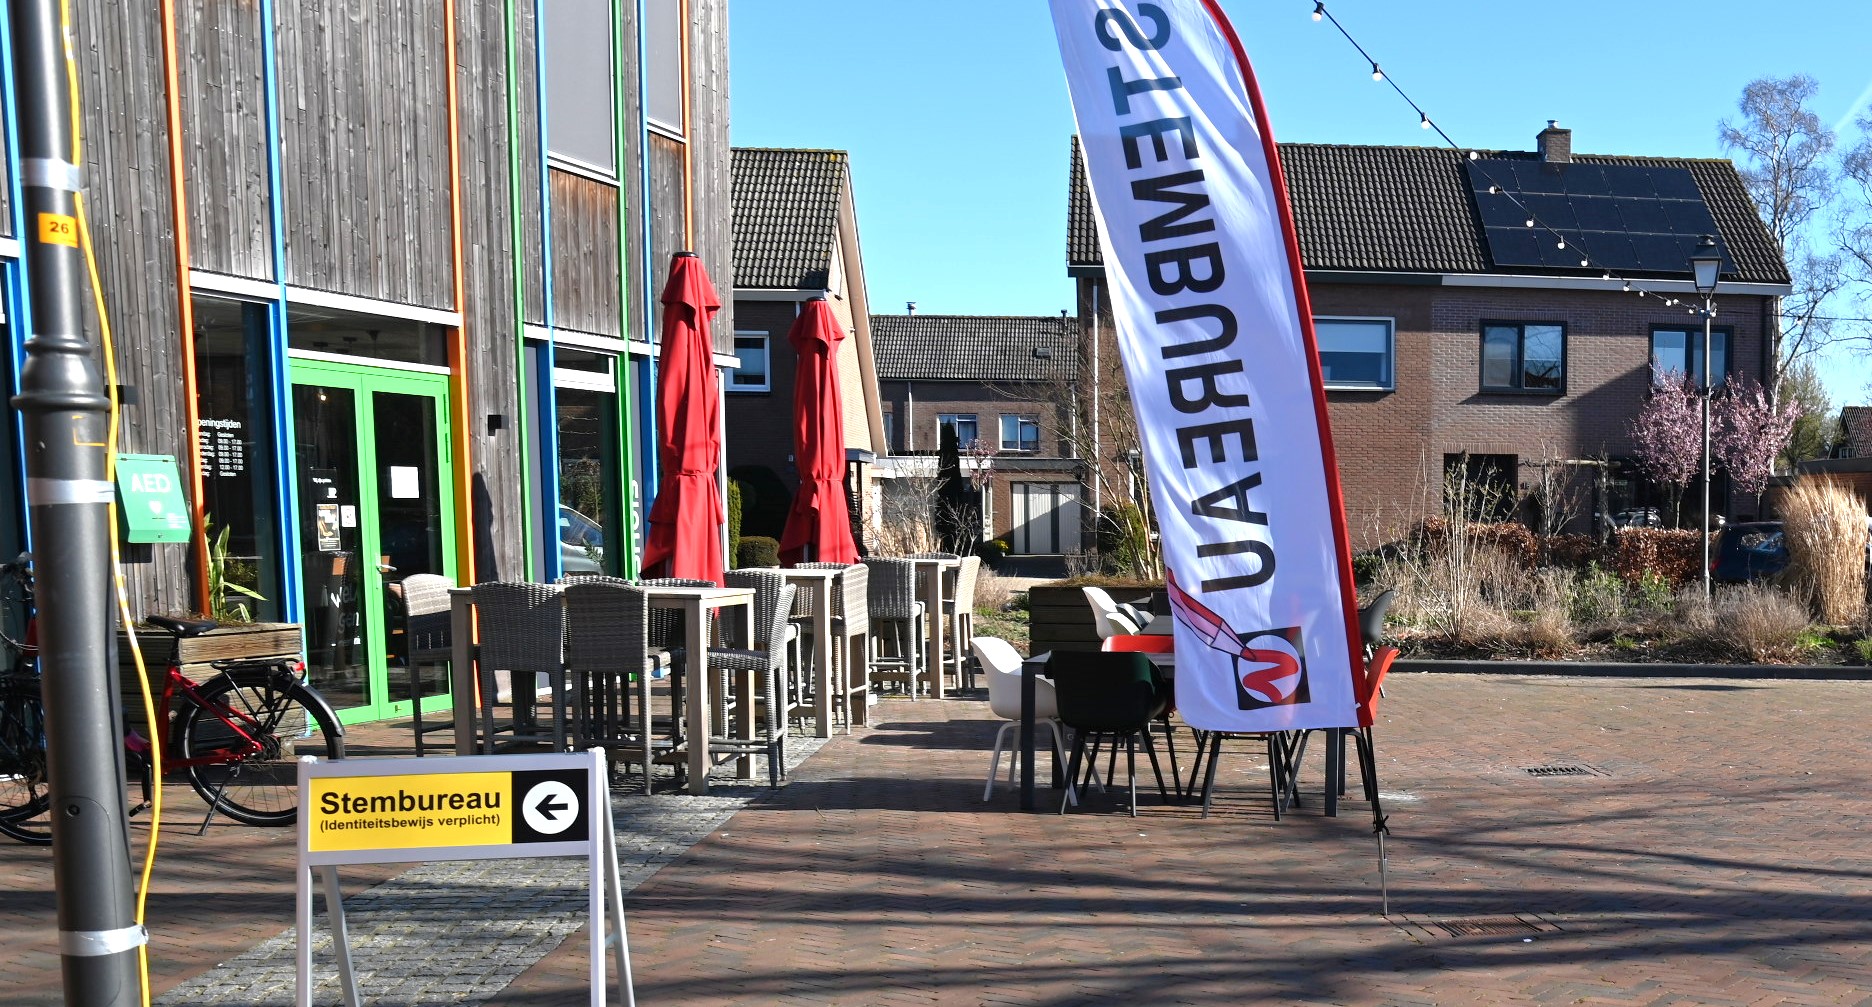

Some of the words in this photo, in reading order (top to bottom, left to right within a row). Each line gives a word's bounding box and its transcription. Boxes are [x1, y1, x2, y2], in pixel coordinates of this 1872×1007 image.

[48, 220, 69, 234] 26
[198, 417, 242, 430] peningstijden
[131, 472, 172, 493] AED
[320, 789, 501, 815] Stembureau
[320, 818, 434, 833] (Identiteitsbewijs
[437, 813, 501, 828] verplicht)
